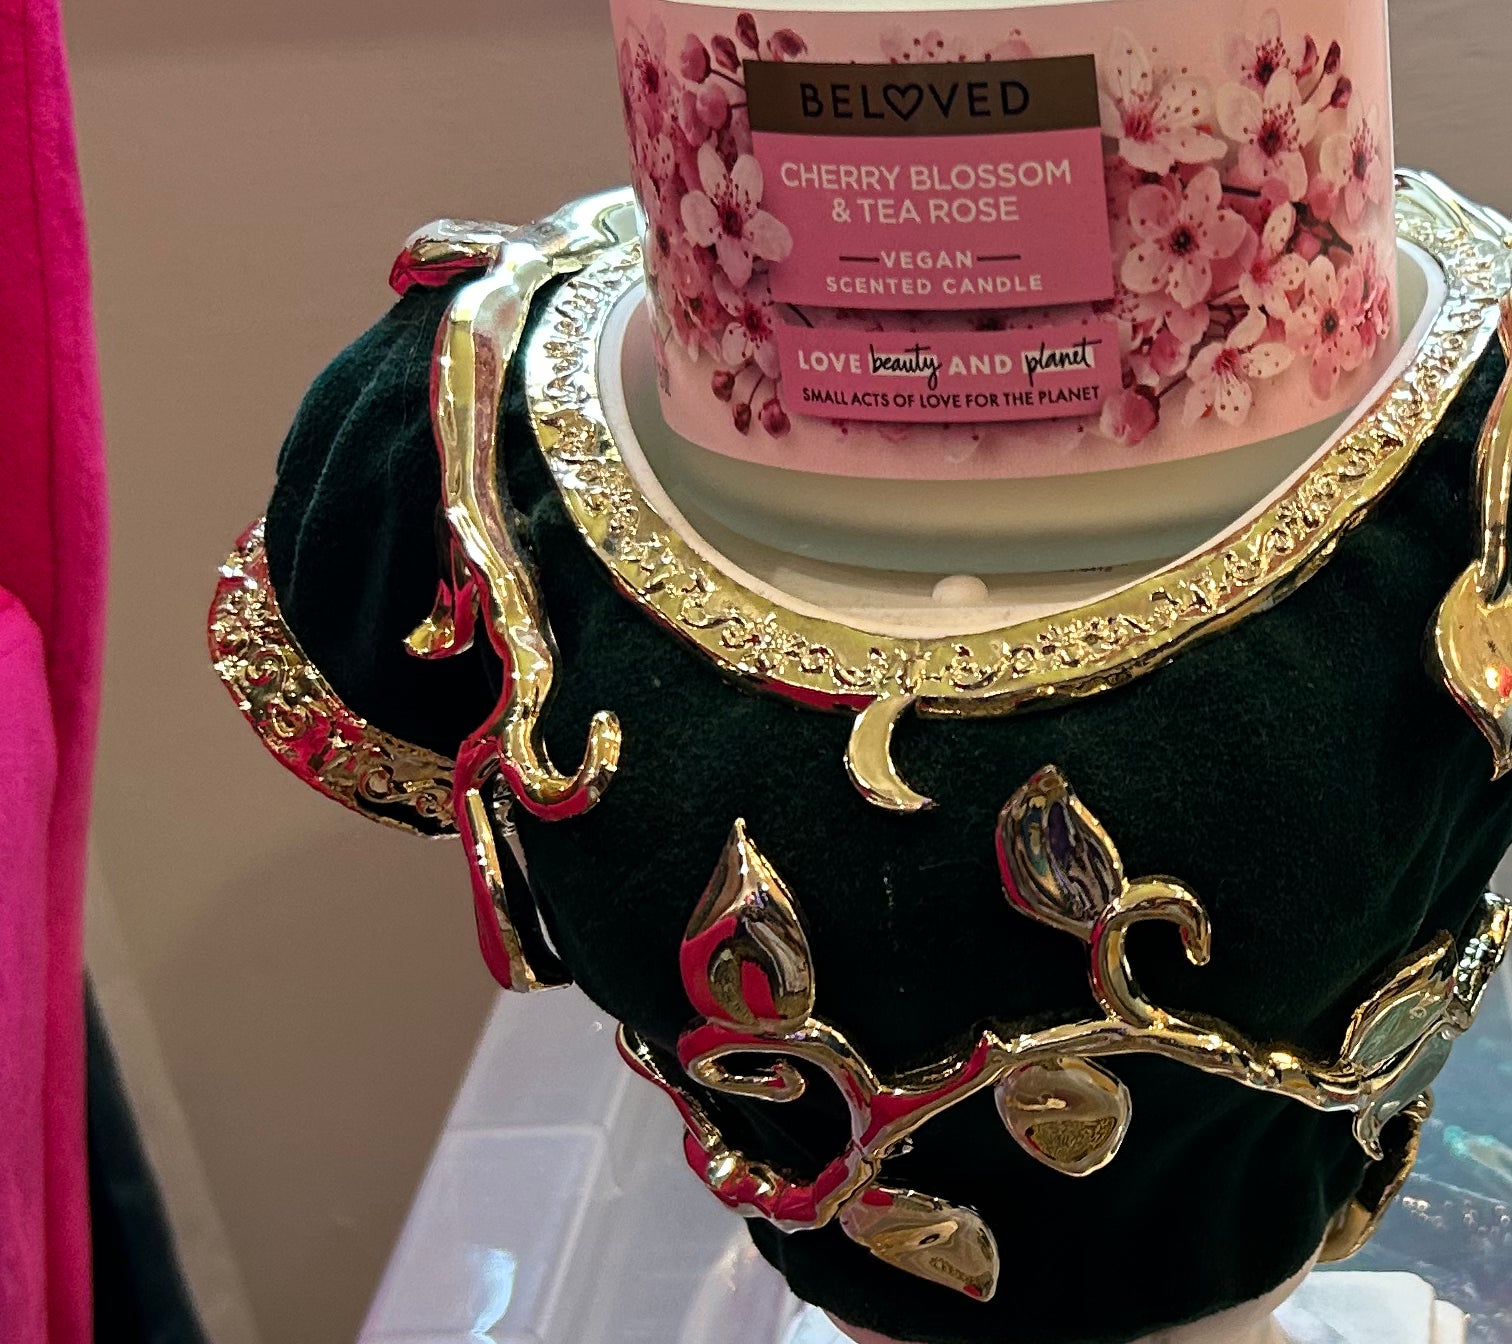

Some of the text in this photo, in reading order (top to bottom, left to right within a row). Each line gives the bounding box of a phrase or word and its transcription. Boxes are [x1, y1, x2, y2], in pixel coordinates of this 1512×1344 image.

[780, 159, 1072, 192] CHERRY BLOSSOM
[831, 196, 1020, 225] & TEA ROSE
[880, 250, 973, 270] VEGAN
[826, 273, 1044, 295] SCENTED CANDLE
[797, 337, 1103, 391] LOVE beauty AND planet
[802, 384, 1101, 409] SMALL ACTS OF LOVE FOR THE PLANET
